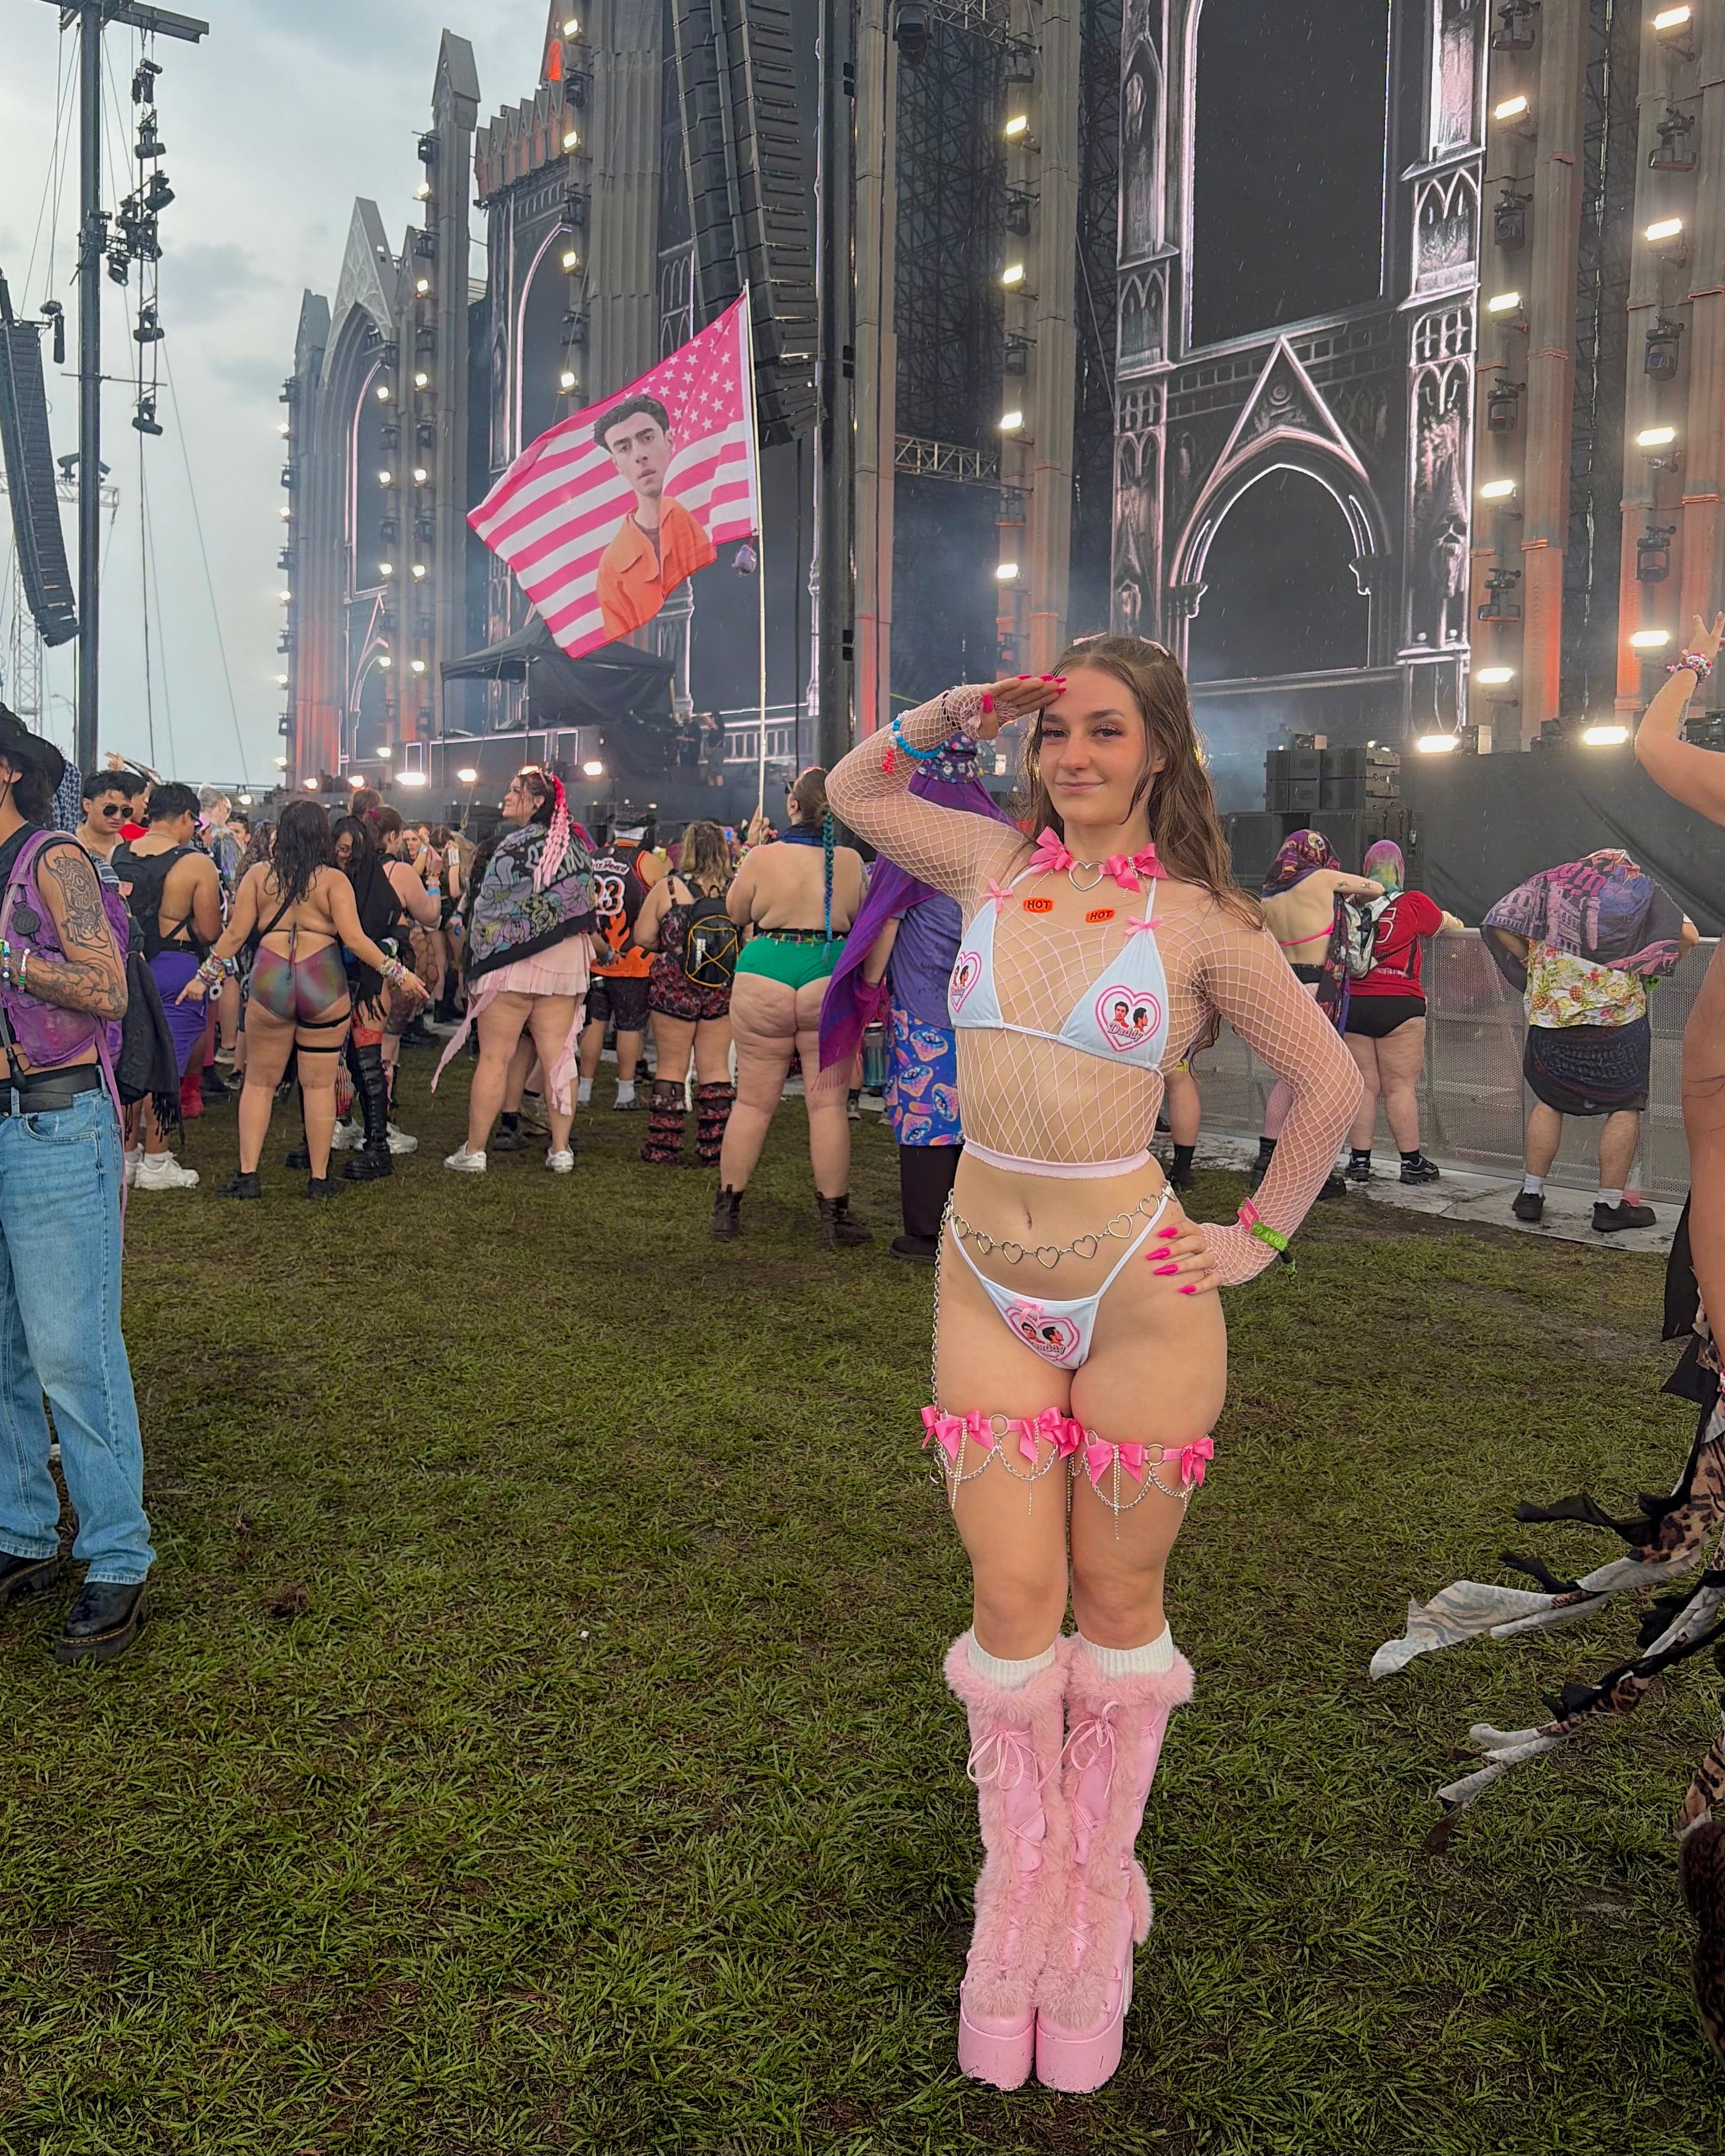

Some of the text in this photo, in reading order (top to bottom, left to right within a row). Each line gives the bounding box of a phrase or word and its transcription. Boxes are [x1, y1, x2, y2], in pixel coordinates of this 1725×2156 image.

[1027, 900, 1050, 909] HOT
[1090, 910, 1112, 920] HOT
[1107, 1022, 1144, 1043] Daddy
